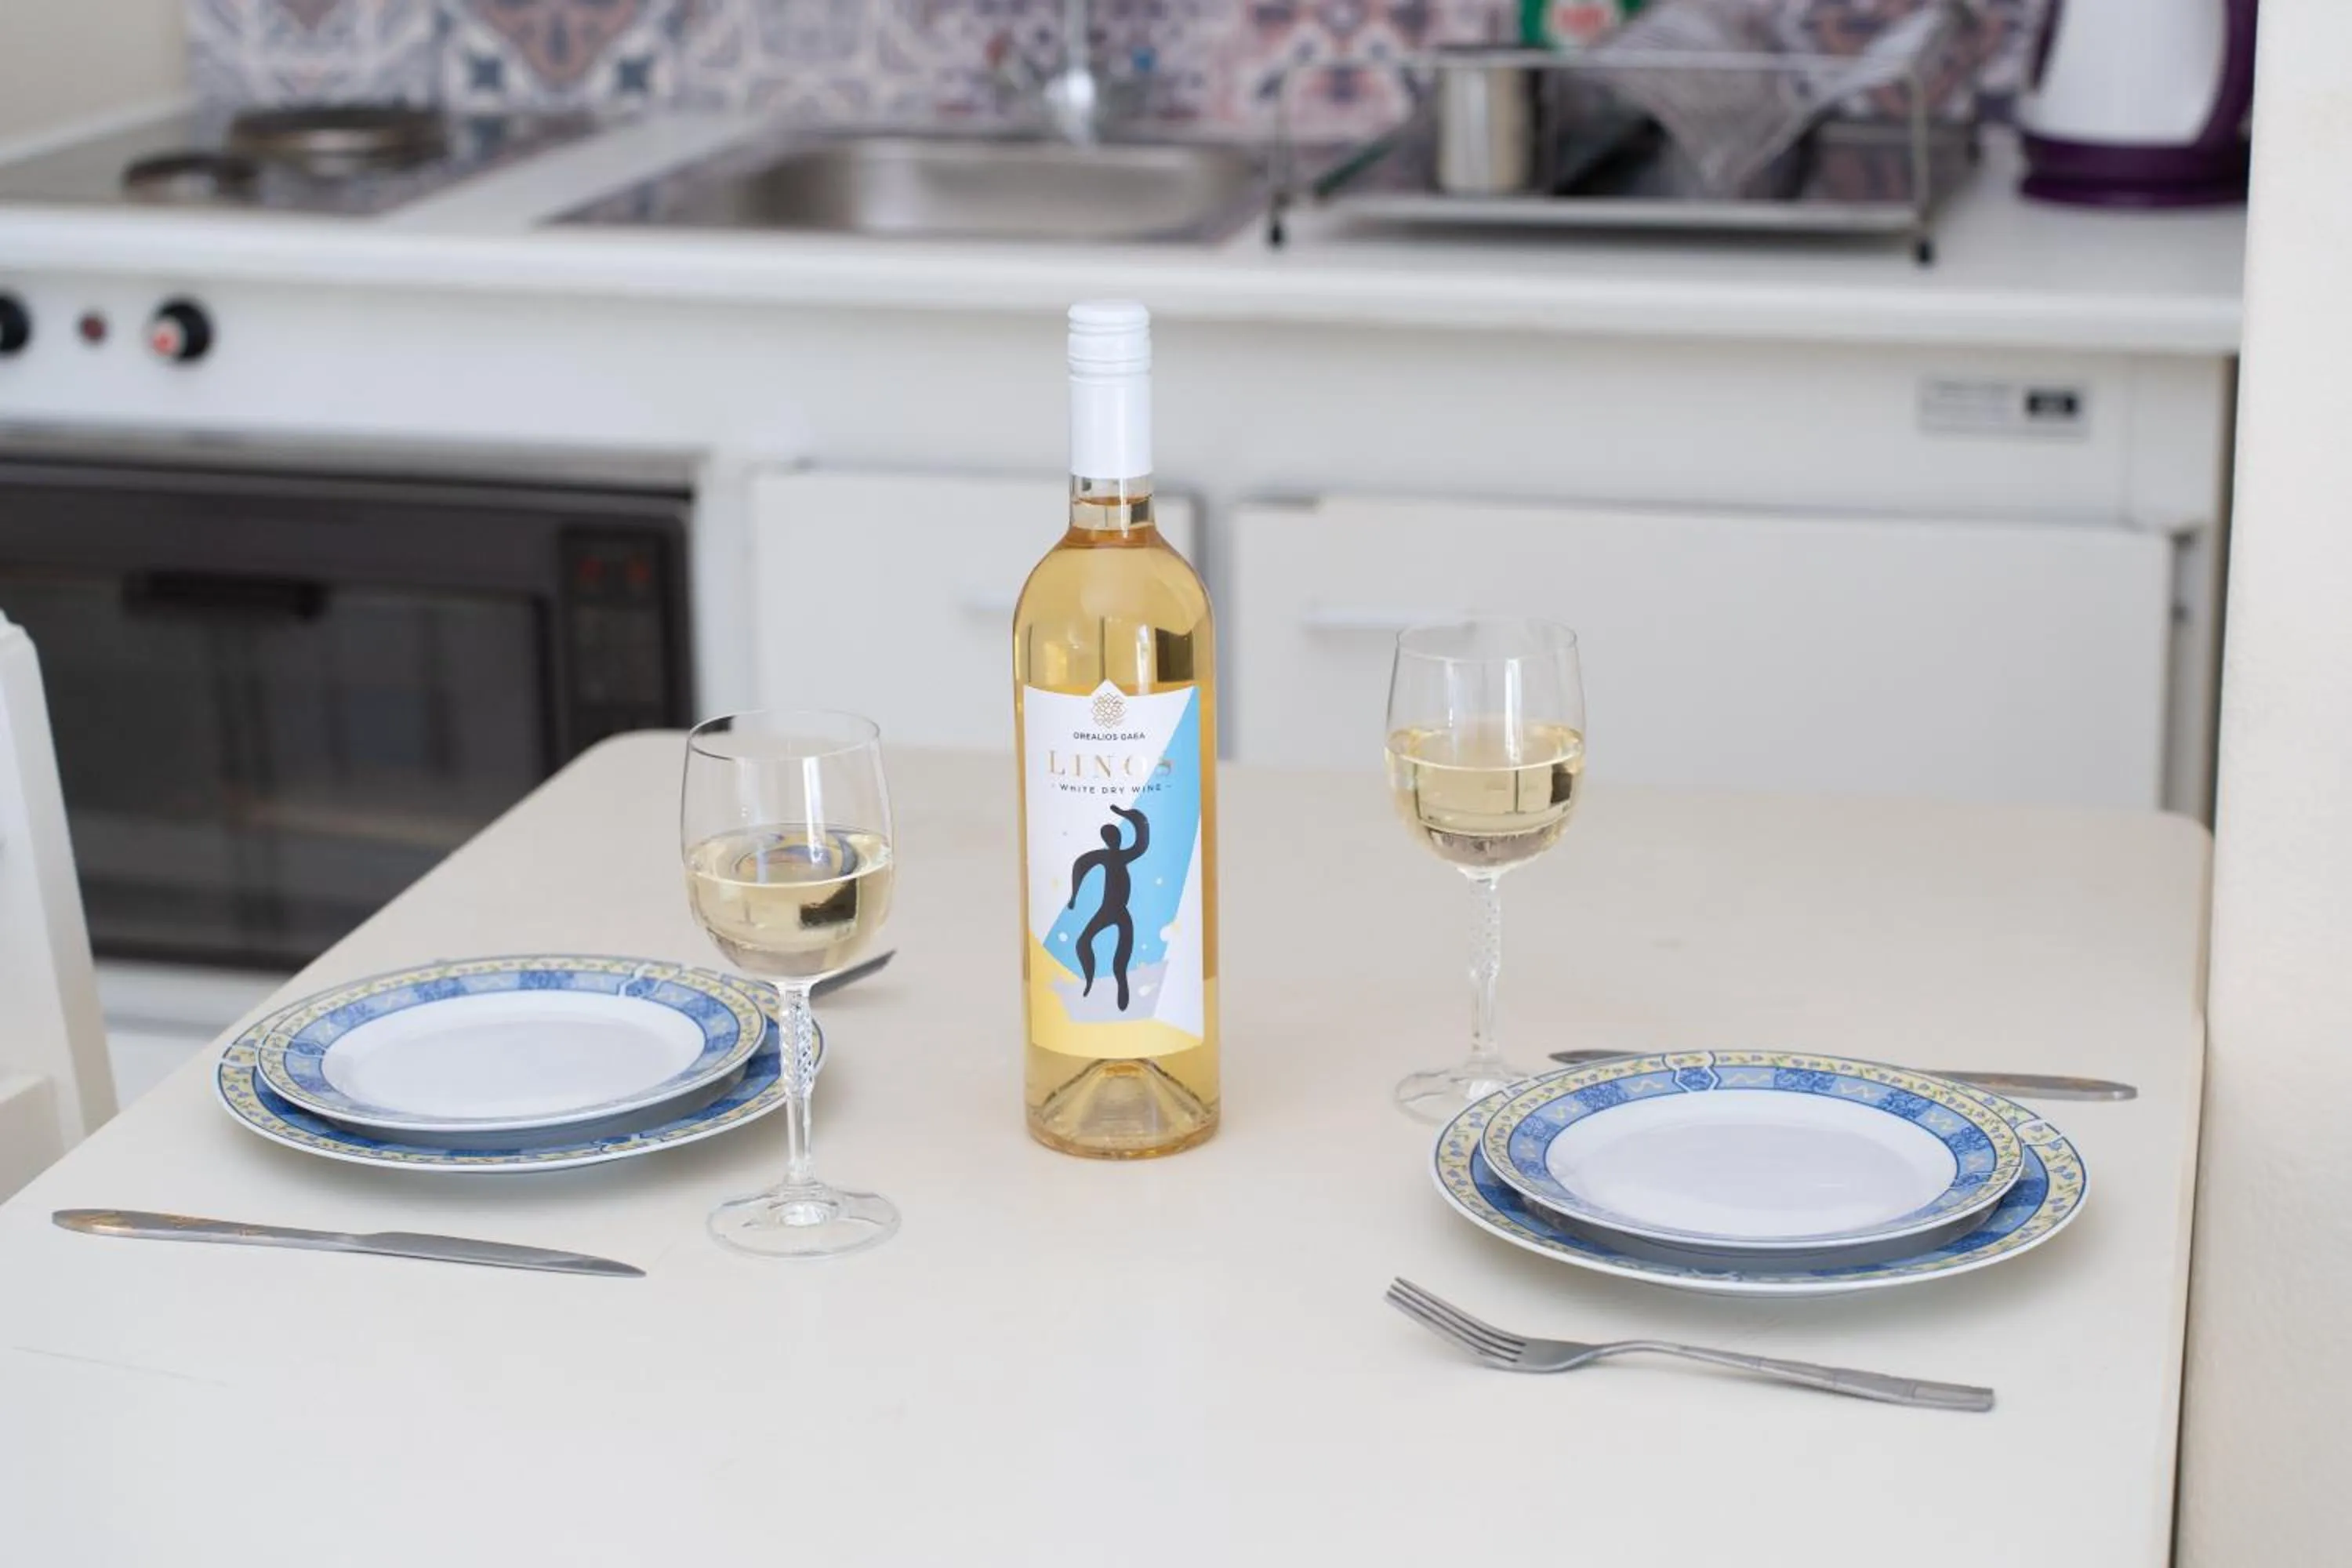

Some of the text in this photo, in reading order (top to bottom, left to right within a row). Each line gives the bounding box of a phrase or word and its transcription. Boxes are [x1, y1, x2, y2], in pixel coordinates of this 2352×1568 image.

[1073, 731, 1145, 741] OREALIOS GAEA
[1049, 750, 1172, 778] LINOS
[1060, 783, 1162, 794] WHITE DRY WINE
